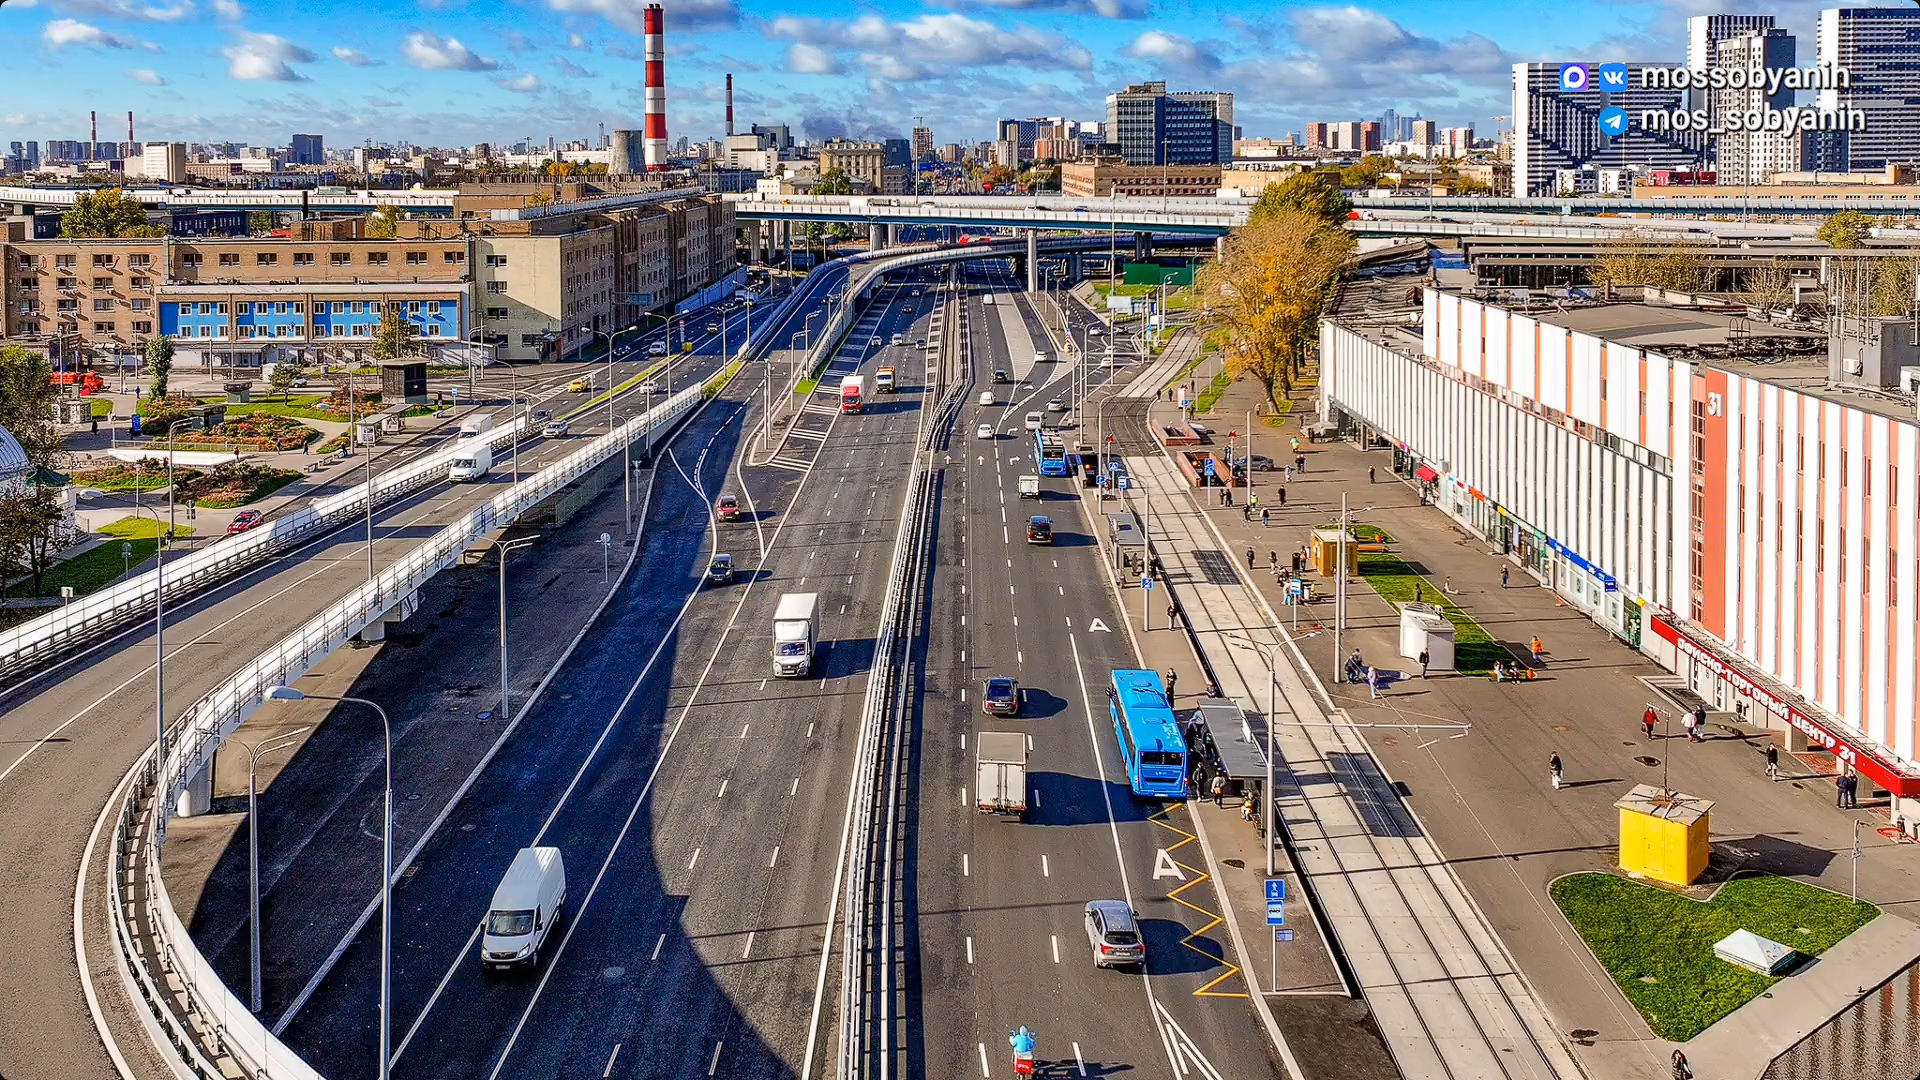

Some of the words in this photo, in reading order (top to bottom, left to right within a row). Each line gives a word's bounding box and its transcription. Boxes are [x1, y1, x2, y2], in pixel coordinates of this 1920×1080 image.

[1706, 391, 1724, 418] 31
[1677, 637, 1790, 720] ОФИСНО-ТОРГОВЫЙ
[1791, 710, 1836, 750] ЦЕНТР
[1839, 744, 1857, 765] 31
